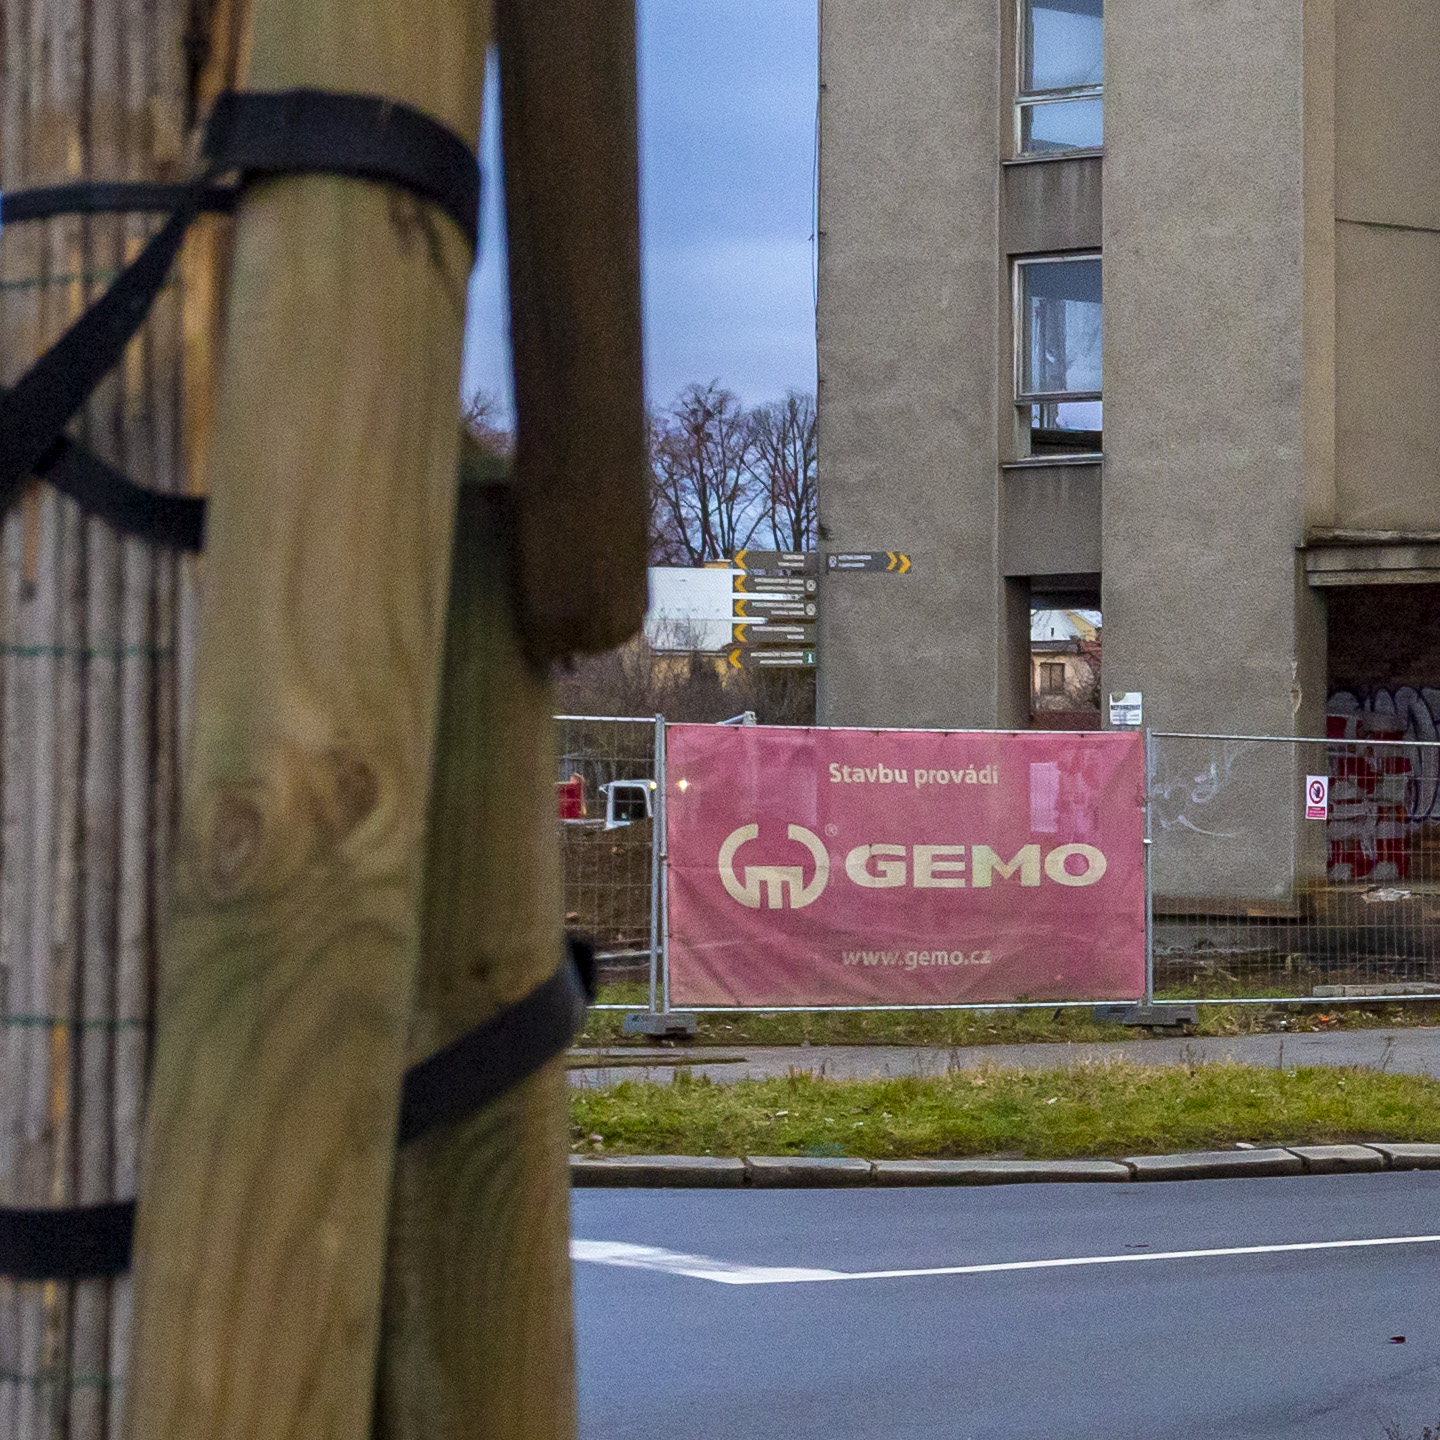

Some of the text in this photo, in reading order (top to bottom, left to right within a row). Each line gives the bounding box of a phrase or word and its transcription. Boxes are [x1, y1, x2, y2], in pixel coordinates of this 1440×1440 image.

[828, 762, 999, 789] Stavbu provádí
[845, 843, 1107, 888] GEMO
[841, 949, 992, 971] www.gemo.cz
